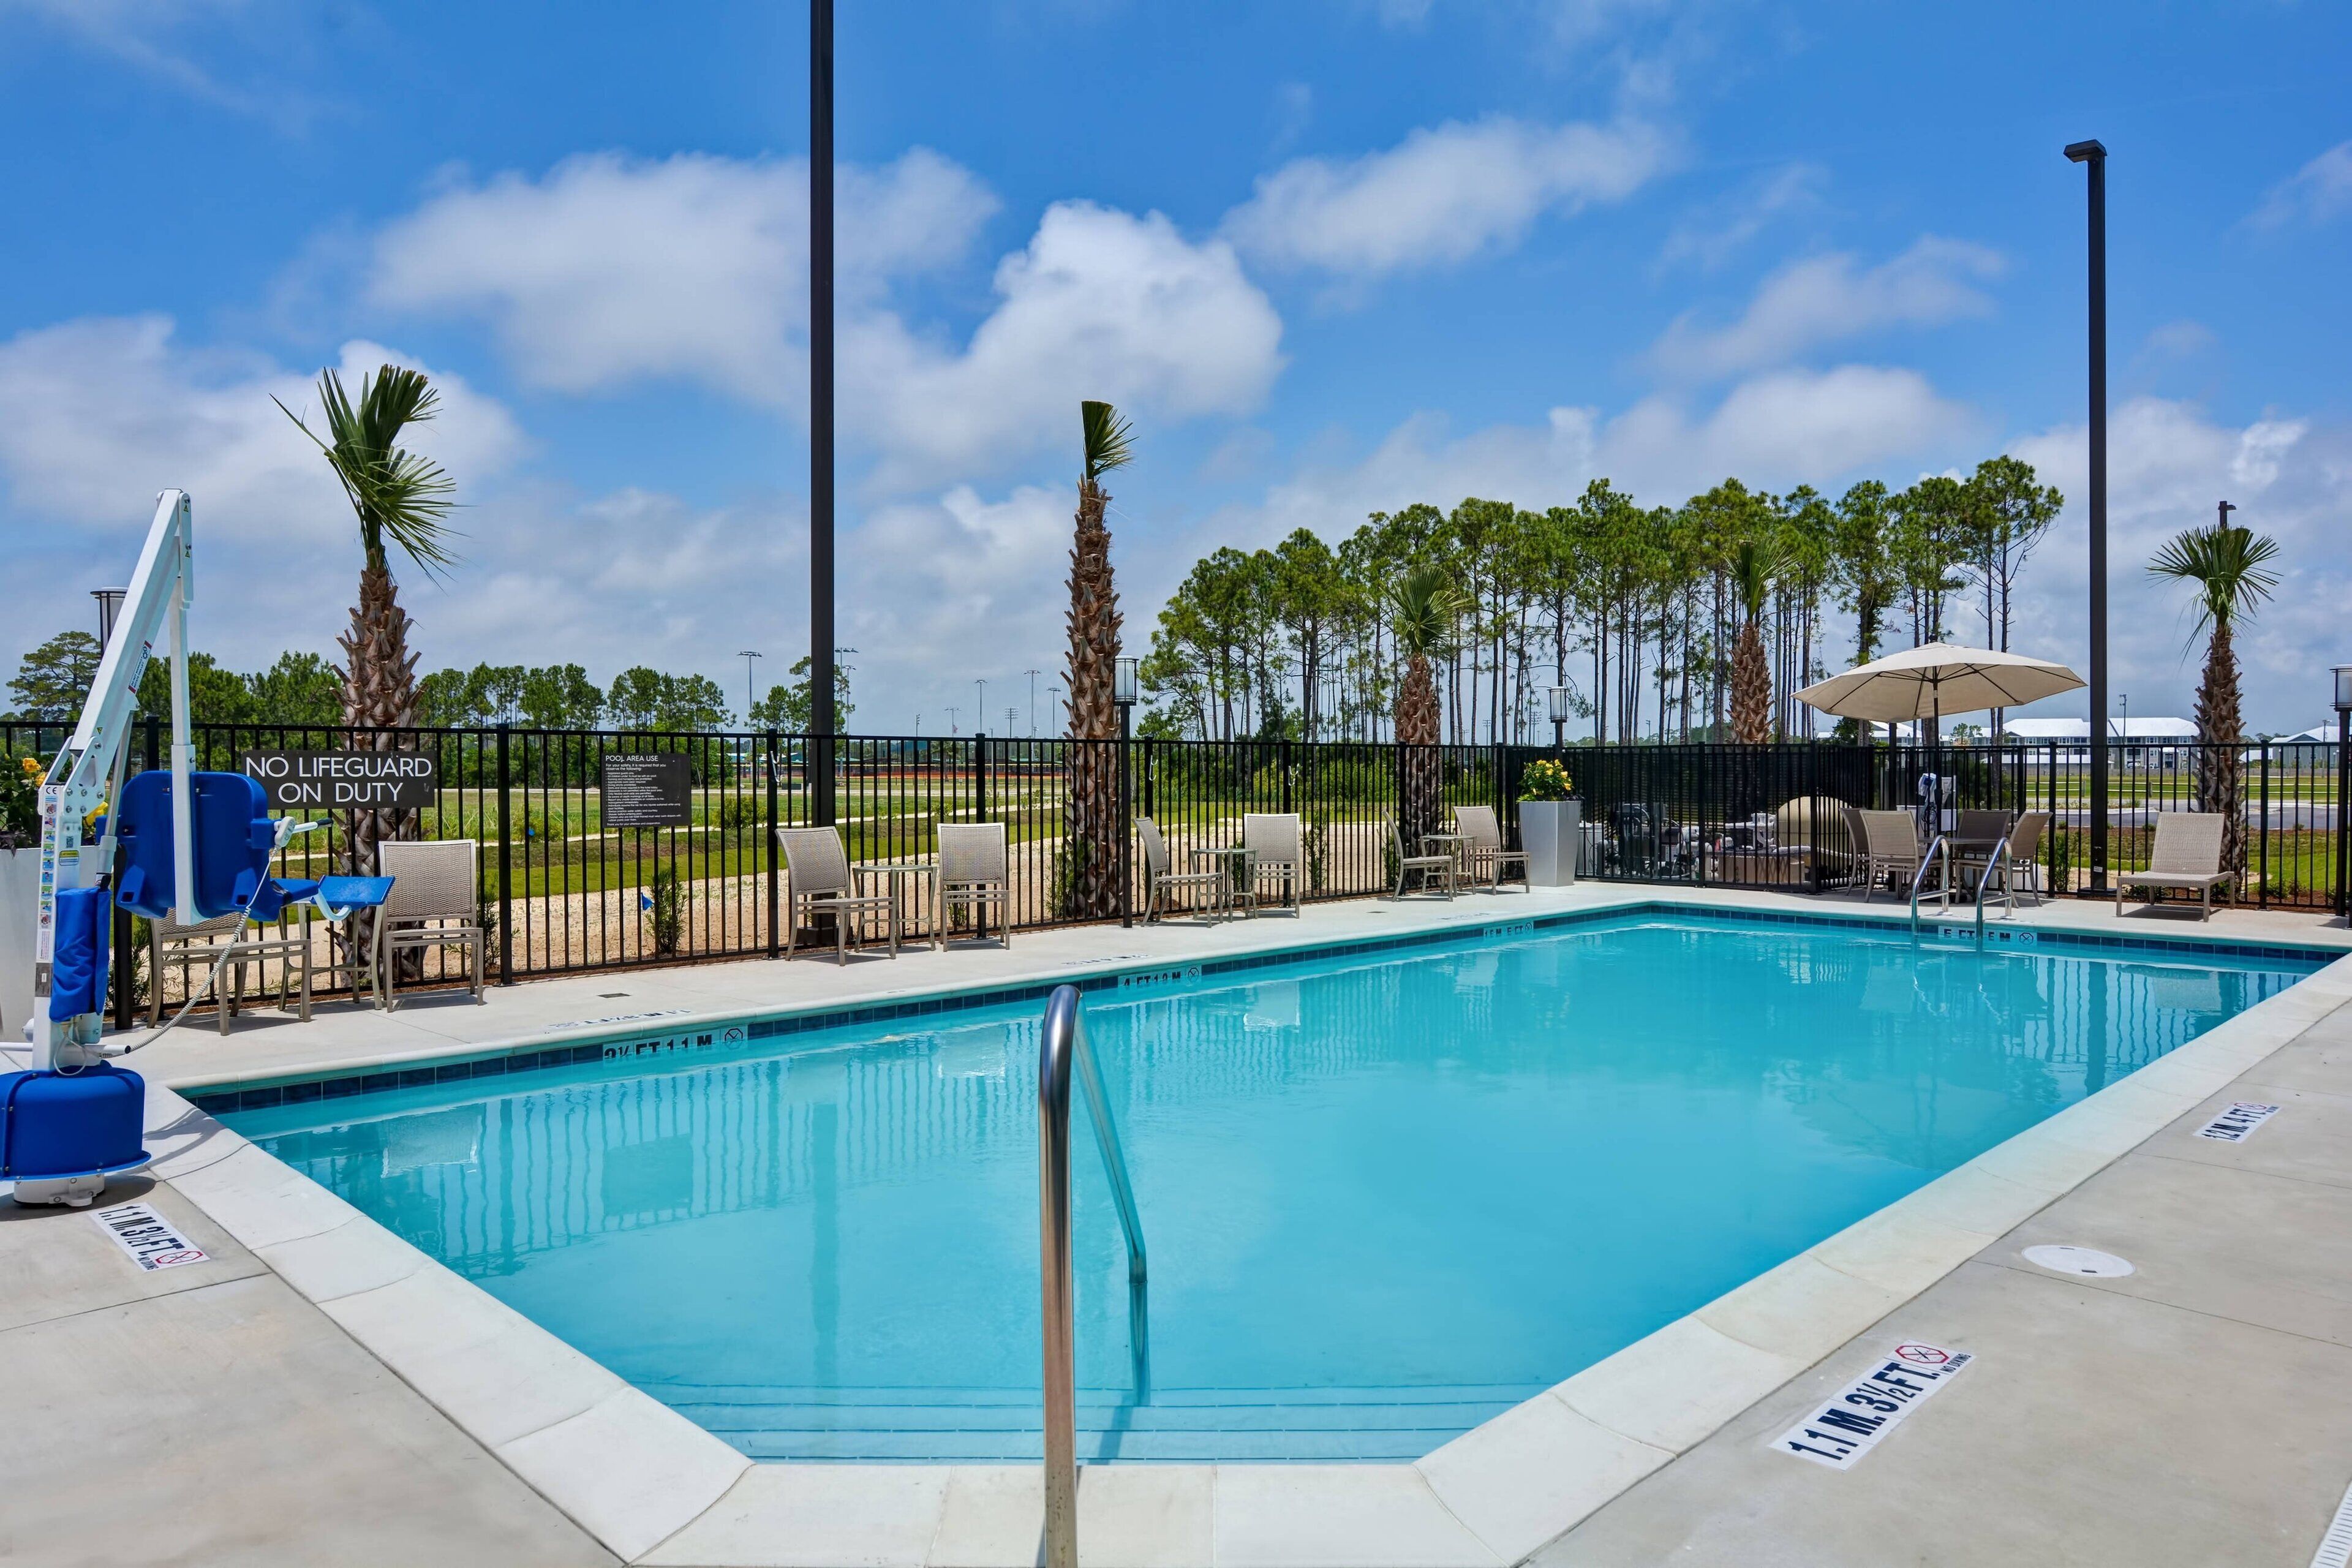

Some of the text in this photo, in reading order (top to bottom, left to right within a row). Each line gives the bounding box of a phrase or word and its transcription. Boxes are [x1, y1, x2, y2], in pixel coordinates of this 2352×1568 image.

[246, 756, 432, 778] NO LIFEGUARD
[46, 786, 57, 795] CE
[278, 782, 404, 804] ON DUTY
[1940, 1353, 1972, 1374] NO DIVING
[1787, 1428, 1859, 1461] 1.1
